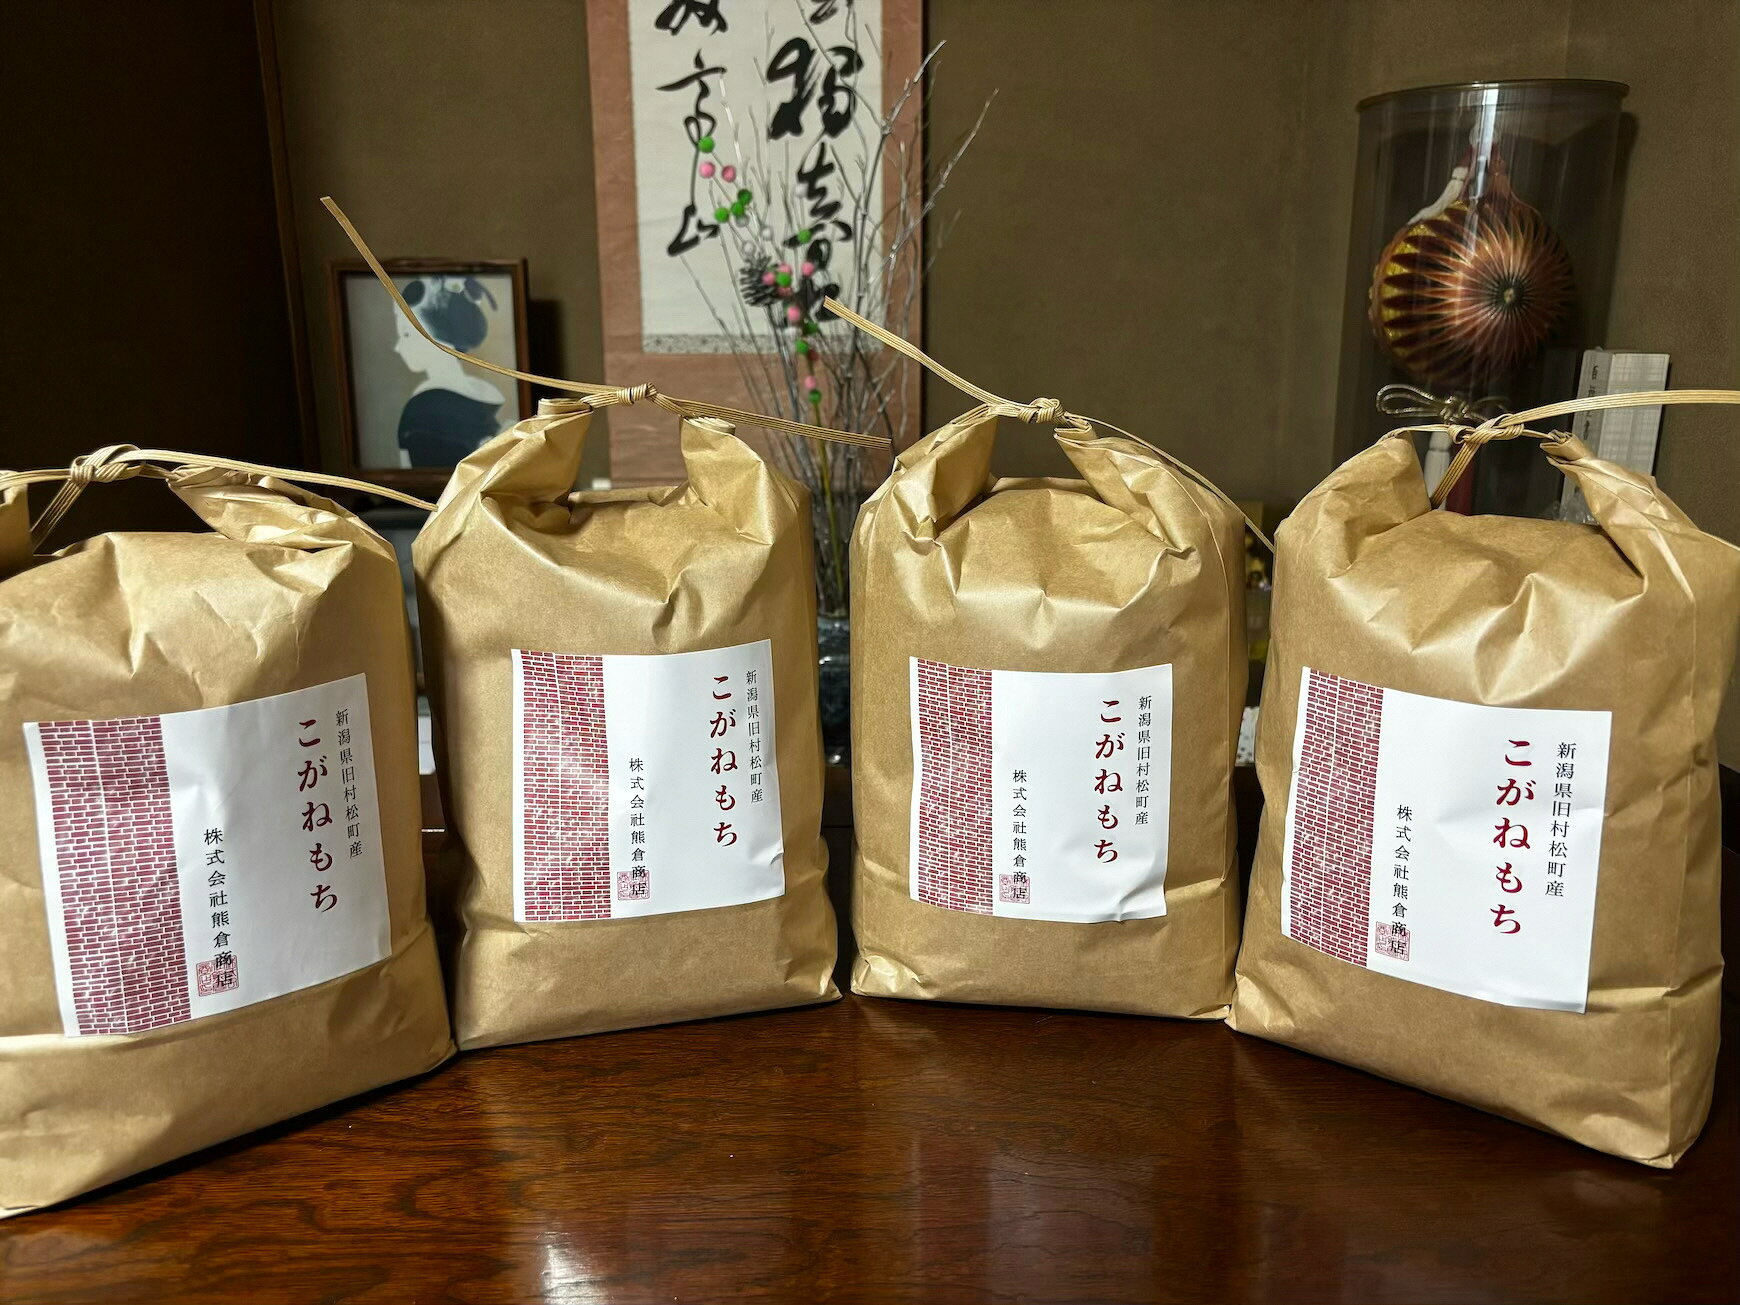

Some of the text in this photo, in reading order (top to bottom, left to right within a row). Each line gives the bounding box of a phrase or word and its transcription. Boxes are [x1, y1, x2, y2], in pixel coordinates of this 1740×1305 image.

[336, 709, 363, 859] 新潟県旧村松町産
[709, 675, 738, 847] こがねもち
[746, 670, 763, 804] 新潟県旧村松町産
[1094, 700, 1125, 863] こがねもち
[1135, 695, 1152, 826] 新潟県旧村松町産
[297, 719, 338, 913] こがねもち
[629, 758, 646, 896] 株式会社熊倉商店
[1012, 769, 1027, 899] 株式会社熊倉商店
[1390, 804, 1412, 956] 株式会社熊倉商店
[1490, 739, 1536, 934] こがねもち
[1545, 742, 1576, 897] 新潟県旧村松町産
[204, 828, 235, 988] 株式会社熊倉商店
